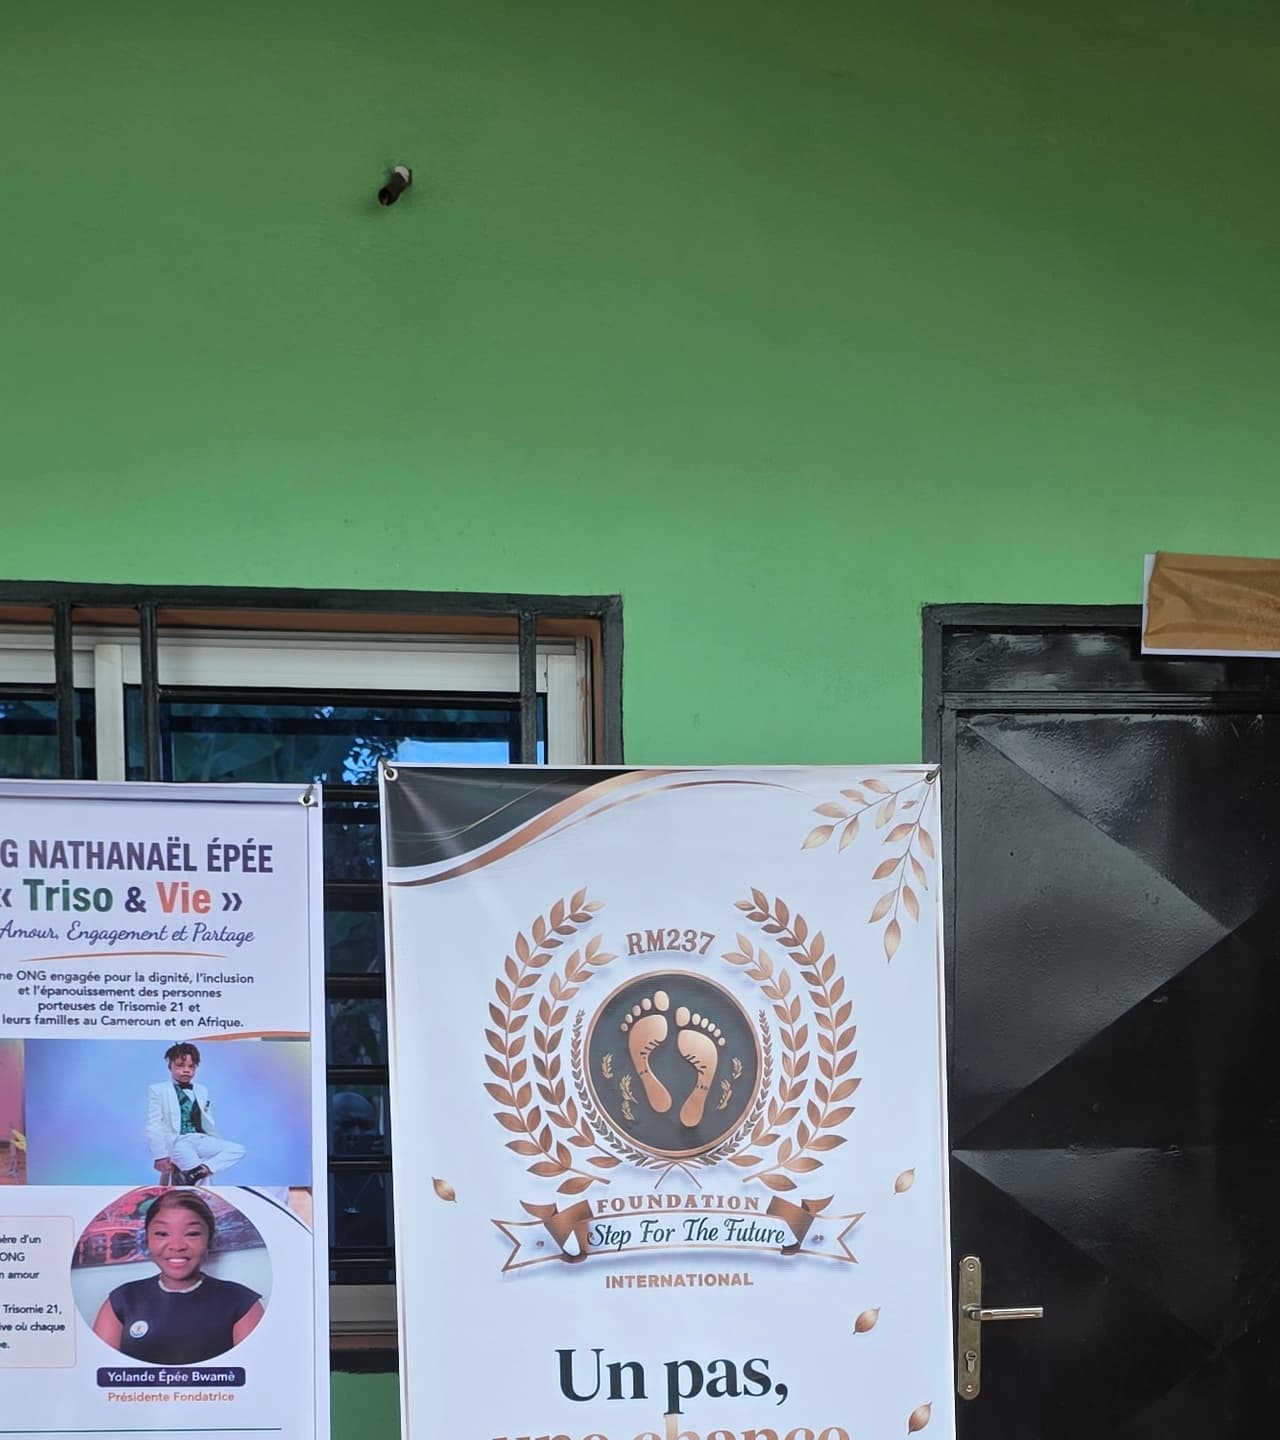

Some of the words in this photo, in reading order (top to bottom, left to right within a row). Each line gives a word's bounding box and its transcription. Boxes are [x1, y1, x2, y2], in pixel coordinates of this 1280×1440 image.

[28, 836, 197, 871] NATHANAËL
[206, 837, 273, 873] ÉPÉE
[22, 878, 113, 912] Triso
[124, 886, 146, 912] &
[156, 881, 211, 914] Vie
[221, 892, 242, 911] »
[66, 920, 168, 945] Engagement
[171, 925, 188, 941] et
[191, 921, 254, 947] Partage
[625, 928, 716, 956] RM237
[15, 969, 46, 981] ONG
[49, 971, 100, 984] engagée
[103, 974, 131, 984] pour
[134, 971, 144, 982] la
[148, 971, 192, 985] dignité,
[195, 972, 254, 983] l'inclusion
[17, 986, 30, 995] et
[33, 985, 135, 998] l'épanouissement
[137, 986, 158, 997] des
[161, 989, 221, 999] personnes
[37, 1001, 96, 1013] porteuses
[99, 1000, 114, 1011] de
[116, 1000, 166, 1011] Trisomie
[169, 1001, 183, 1012] 21
[188, 1003, 200, 1012] et
[2, 1013, 31, 1024] leurs
[33, 1013, 79, 1025] familles
[82, 1017, 97, 1025] au
[100, 1015, 160, 1026] Cameroun
[164, 1017, 176, 1026] et
[179, 1018, 194, 1026] en
[197, 1015, 243, 1029] Afrique.
[596, 1194, 760, 1213] FOUNDATION
[19, 1234, 41, 1243] d'un
[587, 1223, 632, 1251] Step
[640, 1219, 675, 1243] For
[683, 1217, 719, 1242] The
[724, 1218, 785, 1244] Future
[605, 1272, 753, 1288] INTERNATIONAL
[107, 1370, 155, 1381] Yolande
[158, 1368, 188, 1384] Épée
[191, 1370, 235, 1381] Bwamè
[554, 1348, 648, 1401] Un
[663, 1358, 788, 1416] pas,
[107, 1391, 169, 1402] Présidente
[173, 1390, 234, 1401] Fondatrice
